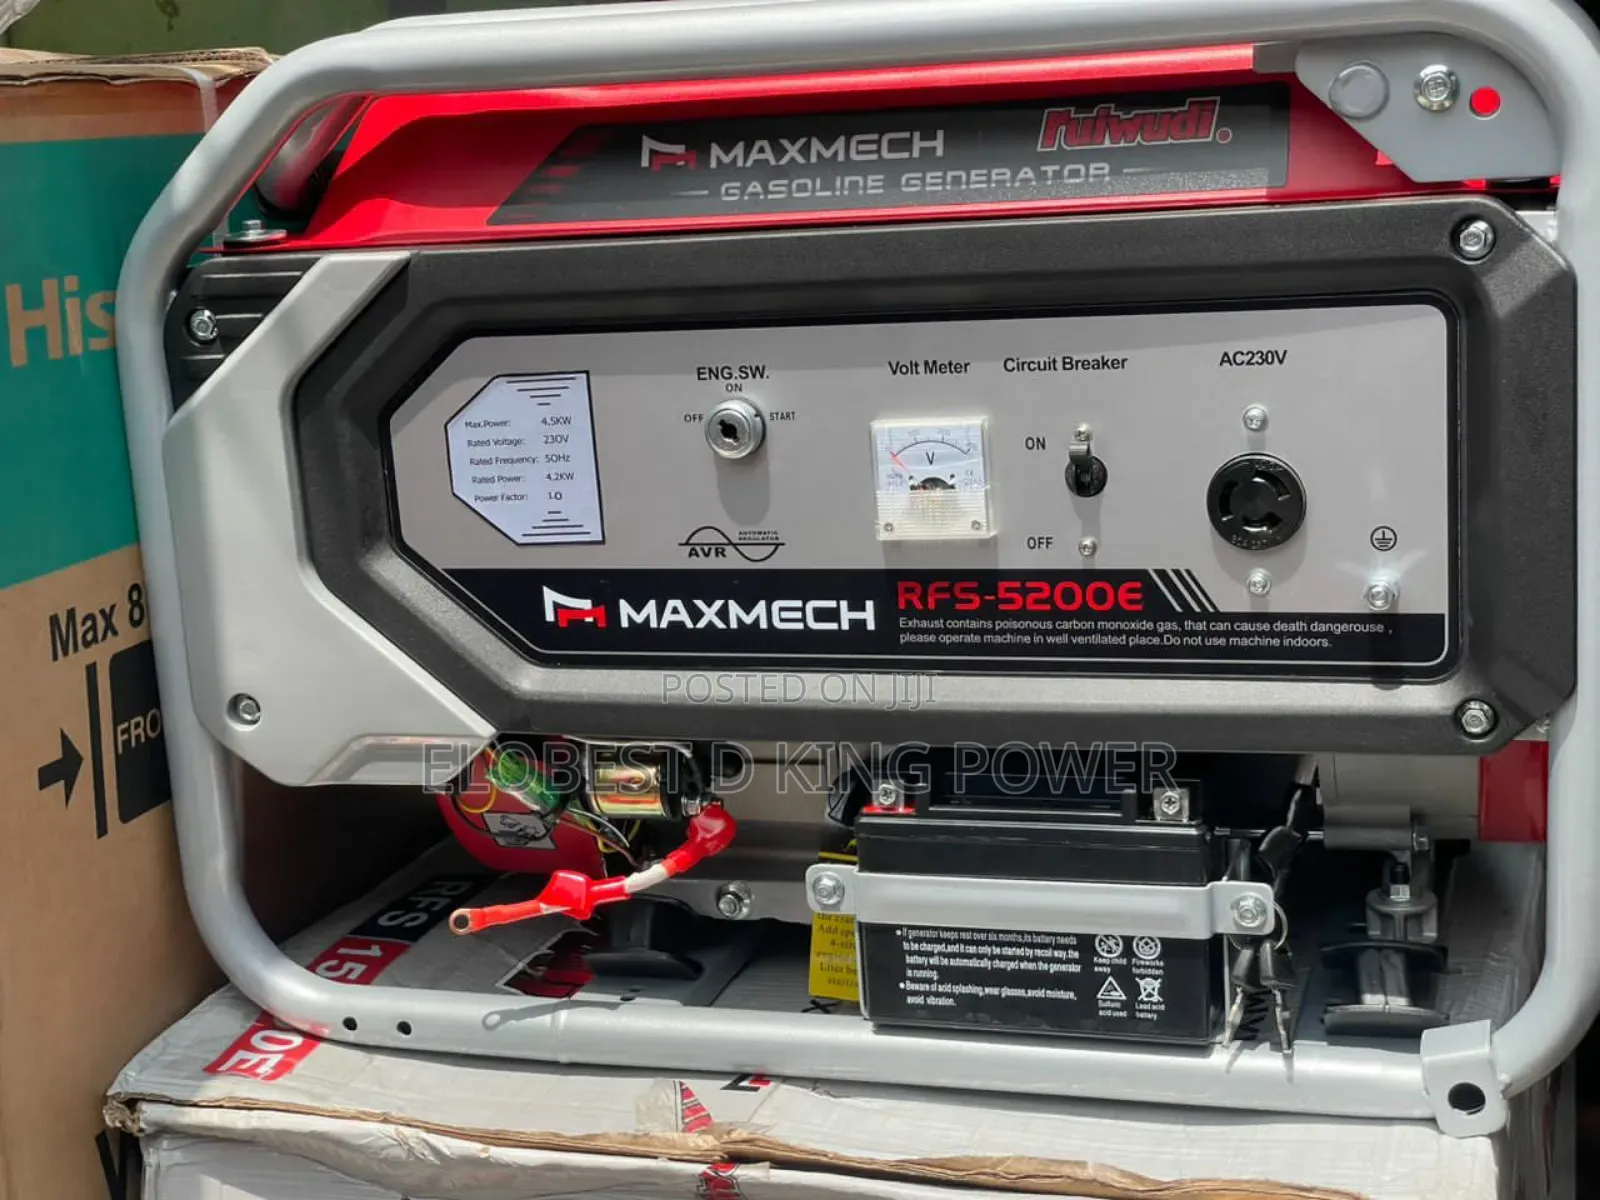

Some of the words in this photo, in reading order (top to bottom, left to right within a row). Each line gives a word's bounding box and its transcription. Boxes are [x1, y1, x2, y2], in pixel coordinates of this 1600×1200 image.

[709, 129, 945, 169] MAXMECH
[720, 174, 884, 201] GASOLINE
[900, 162, 1111, 193] GENERATOR
[1003, 356, 1057, 374] Circuit
[1062, 355, 1128, 372] Breaker
[1219, 350, 1288, 368] AC230V
[696, 364, 770, 381] ENG.SW.
[888, 360, 920, 376] Volt
[925, 359, 971, 375] Meter
[725, 383, 743, 393] ON
[541, 416, 572, 426] 4.5KW
[684, 413, 705, 423] OFF
[769, 411, 796, 421] START
[467, 438, 491, 448] Rated
[1024, 436, 1046, 451] ON
[469, 456, 493, 466] Rated
[925, 451, 935, 466] V
[471, 474, 496, 484] Rated
[545, 472, 575, 481] 4.2KW
[474, 494, 498, 503] Power
[1026, 536, 1054, 551] OFF
[688, 547, 727, 558] AVR
[897, 580, 1144, 612] RFS-5200E
[619, 599, 875, 631] MAXMECH
[49, 603, 119, 662] Max
[899, 617, 944, 629] Exhaust
[946, 618, 993, 629] contains
[995, 619, 1053, 631] poisonous
[1055, 619, 1095, 630] carbon
[1097, 619, 1154, 631] monoxide
[1156, 621, 1182, 633] gas,
[1184, 619, 1207, 631] that
[1209, 621, 1231, 631] can
[1233, 621, 1271, 632] cause
[1273, 621, 1307, 632] death
[1310, 621, 1385, 635] dangerouse
[900, 631, 936, 644] please
[938, 633, 981, 645] operate
[983, 632, 1031, 644] machine
[1033, 633, 1044, 644] in
[1045, 633, 1069, 645] well
[1071, 633, 1127, 645] ventilated
[1183, 635, 1202, 646] not
[1204, 637, 1226, 646] use
[1229, 635, 1280, 647] machine
[1283, 635, 1333, 648] indoors.
[378, 880, 473, 928] RFS
[908, 928, 939, 940] generator
[973, 932, 987, 941] over
[903, 941, 910, 951] to
[910, 941, 919, 951] be
[905, 954, 928, 967] battery
[940, 955, 950, 966] be
[992, 958, 1019, 972] charged
[1037, 960, 1049, 971] the
[938, 982, 952, 992] acid
[906, 994, 925, 1005] avoid
